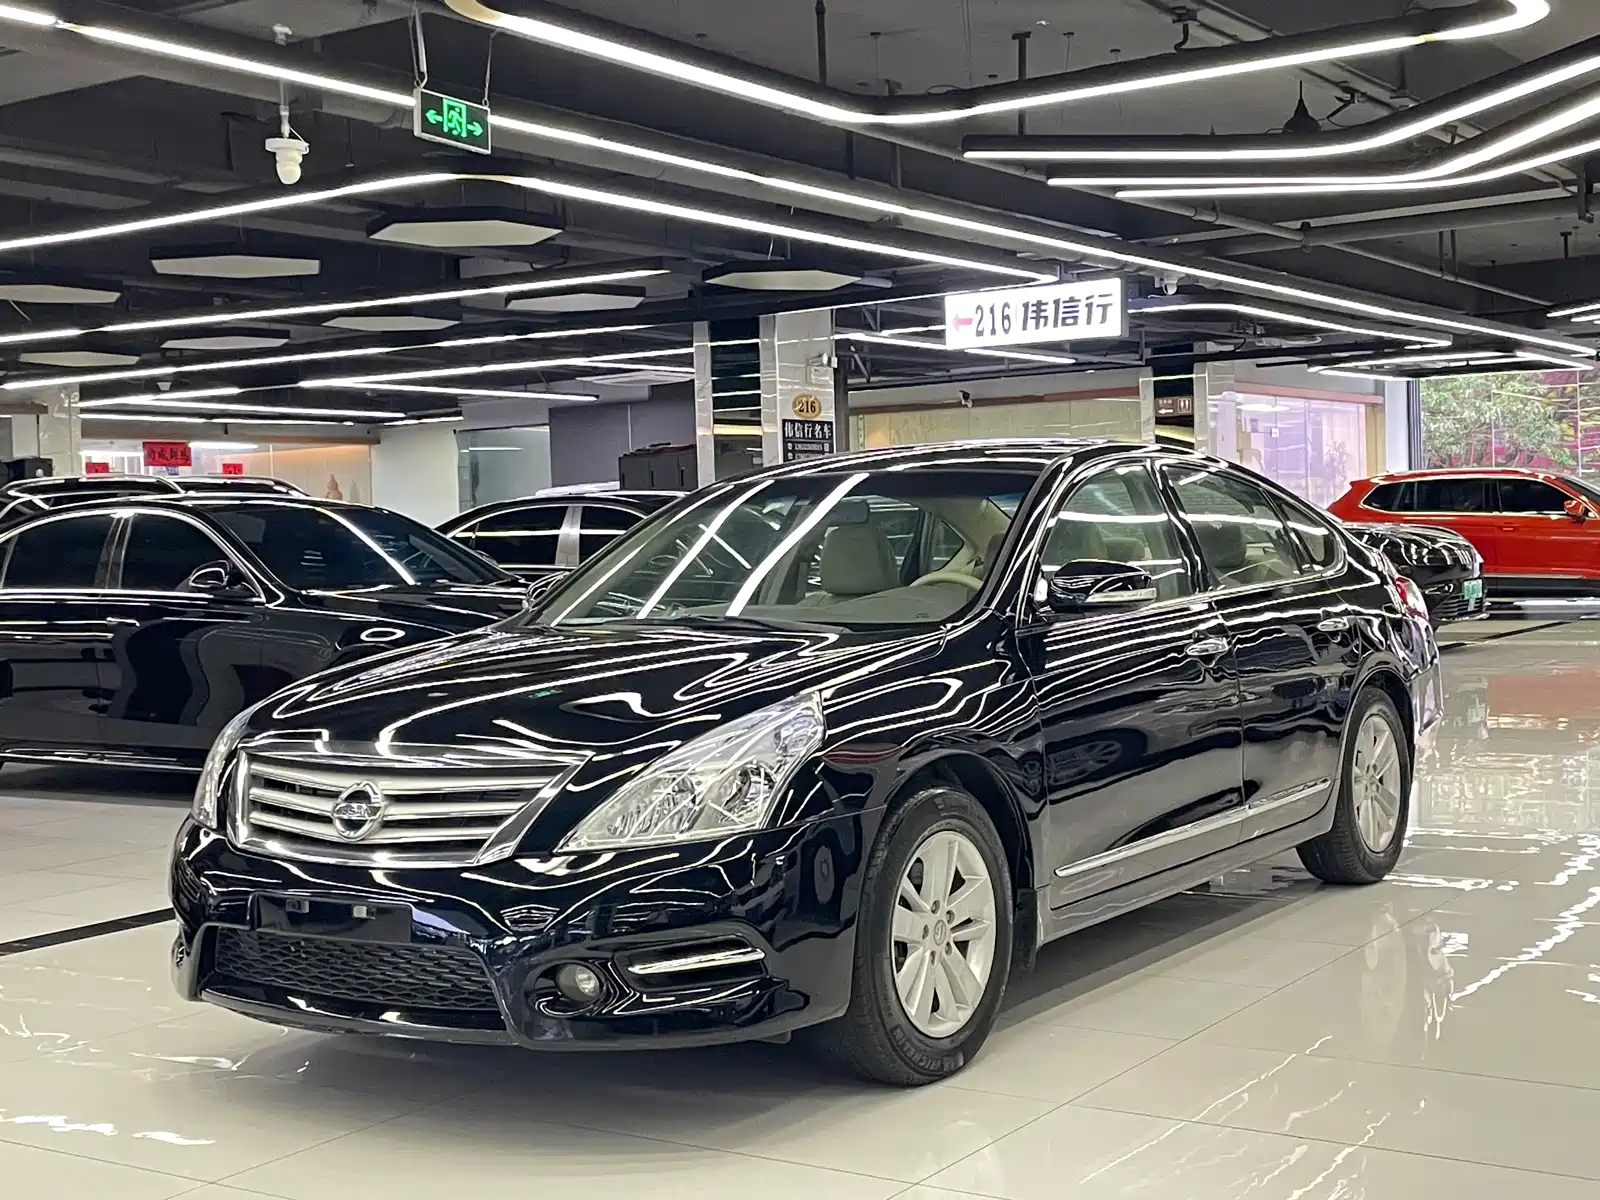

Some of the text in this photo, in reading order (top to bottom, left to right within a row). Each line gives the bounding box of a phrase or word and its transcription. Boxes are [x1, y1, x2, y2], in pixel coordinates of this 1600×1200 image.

[975, 293, 1114, 337] 216 伟信行
[798, 400, 816, 413] 216
[784, 421, 832, 439] 伟信行名车
